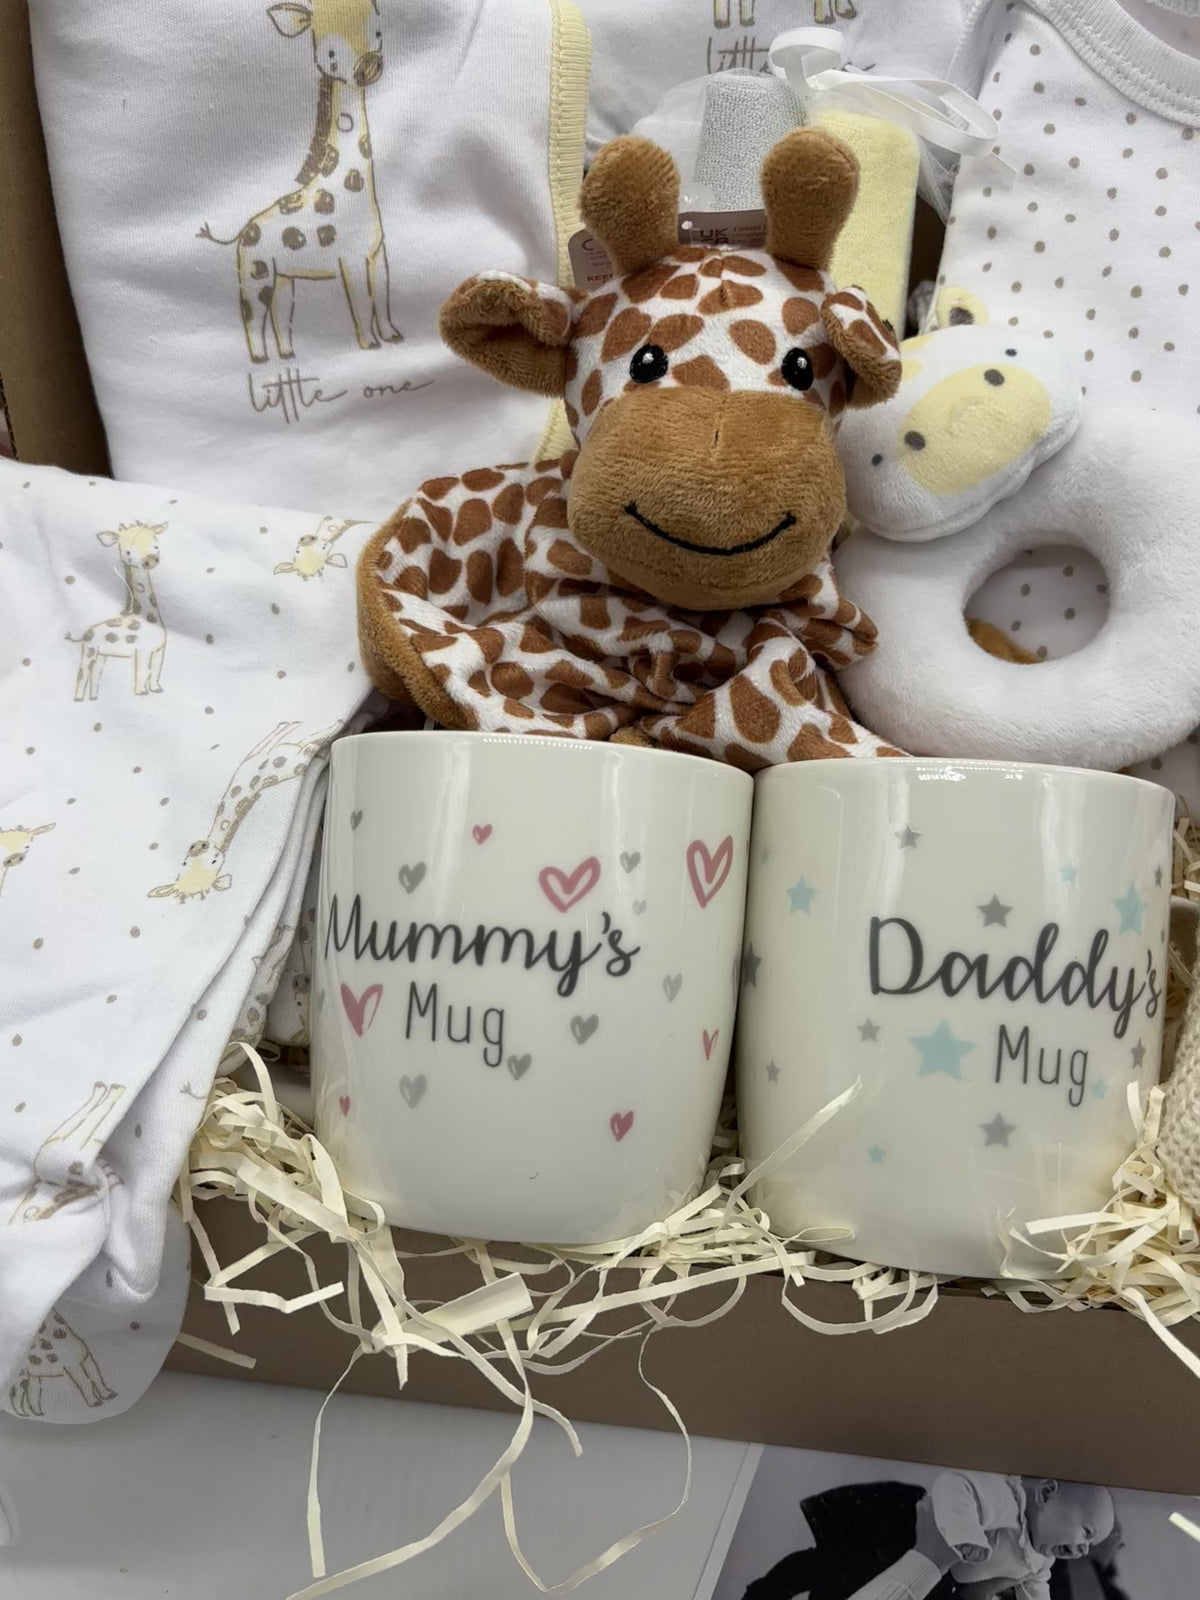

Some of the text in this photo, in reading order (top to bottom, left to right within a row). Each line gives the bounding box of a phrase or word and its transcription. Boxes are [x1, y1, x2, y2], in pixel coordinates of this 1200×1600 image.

[362, 379, 435, 399] one
[324, 893, 641, 998] Mummy's
[868, 915, 1162, 1040] Daddy's
[405, 980, 505, 1068] Mug
[994, 1023, 1089, 1108] Mug
